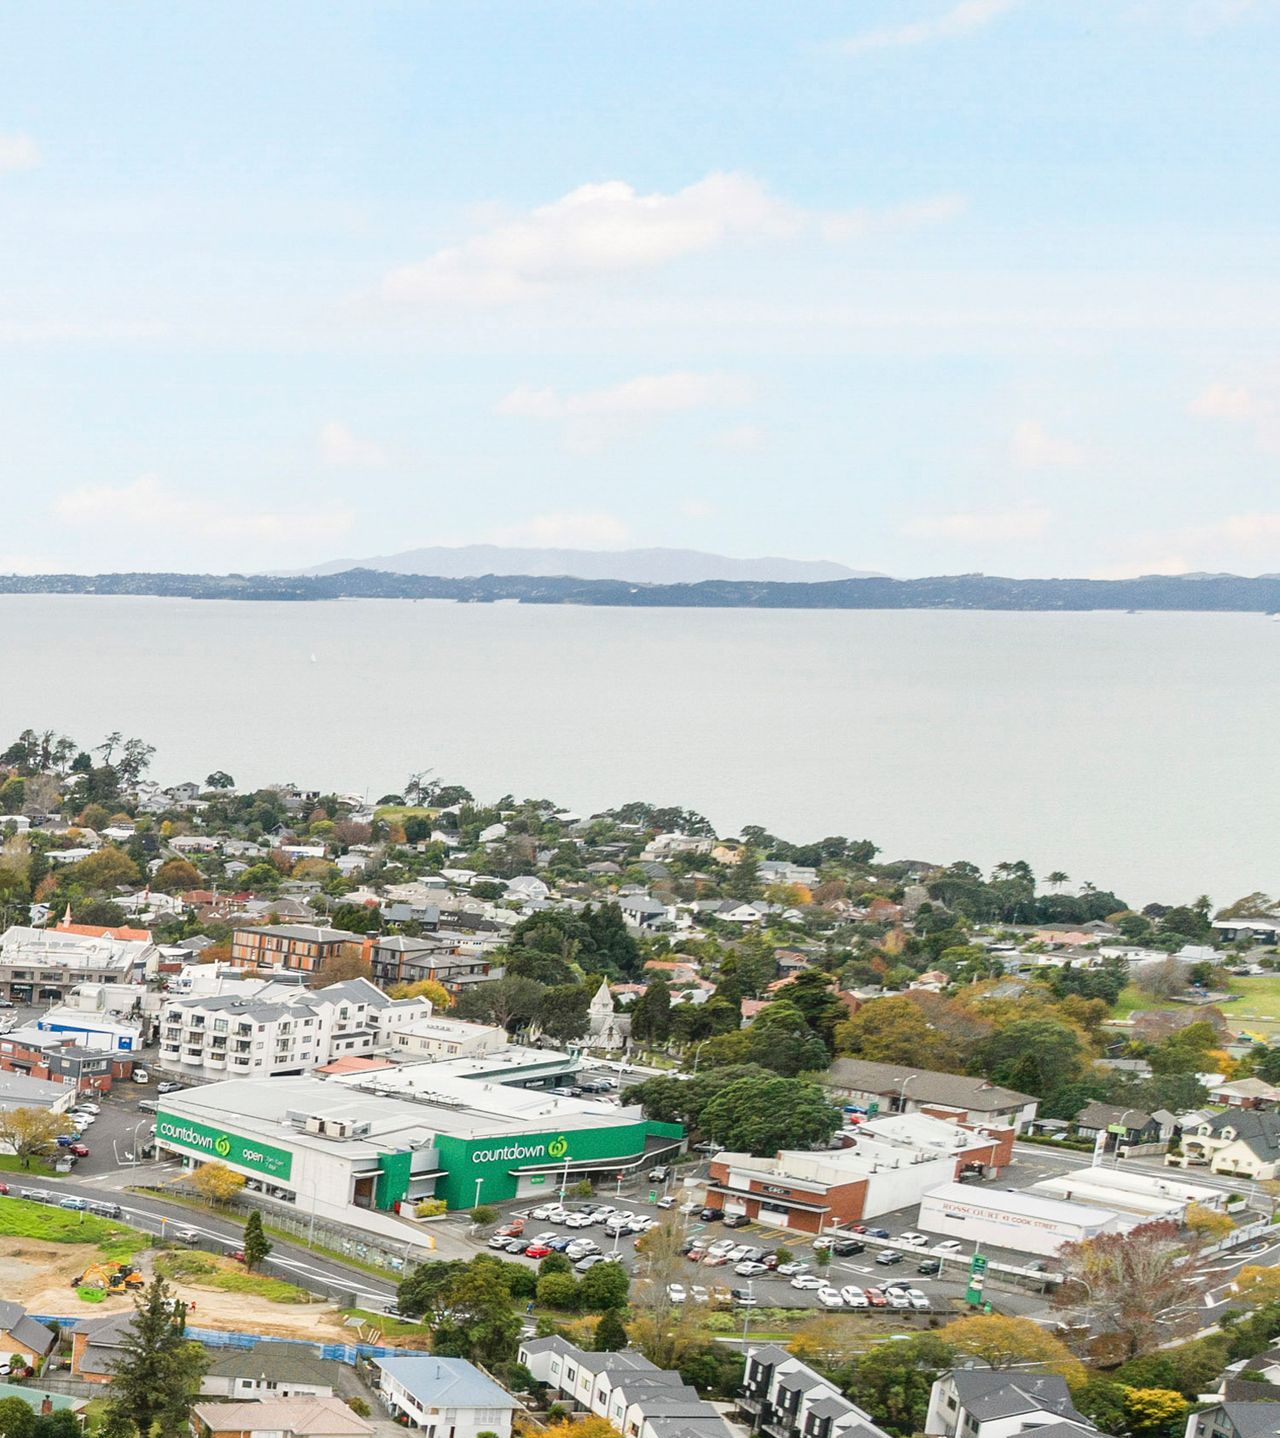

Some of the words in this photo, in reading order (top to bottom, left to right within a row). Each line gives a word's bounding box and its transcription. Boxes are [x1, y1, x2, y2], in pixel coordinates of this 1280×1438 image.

[160, 1123, 213, 1150] countdown
[242, 1148, 264, 1163] open
[472, 1143, 545, 1163] countdown
